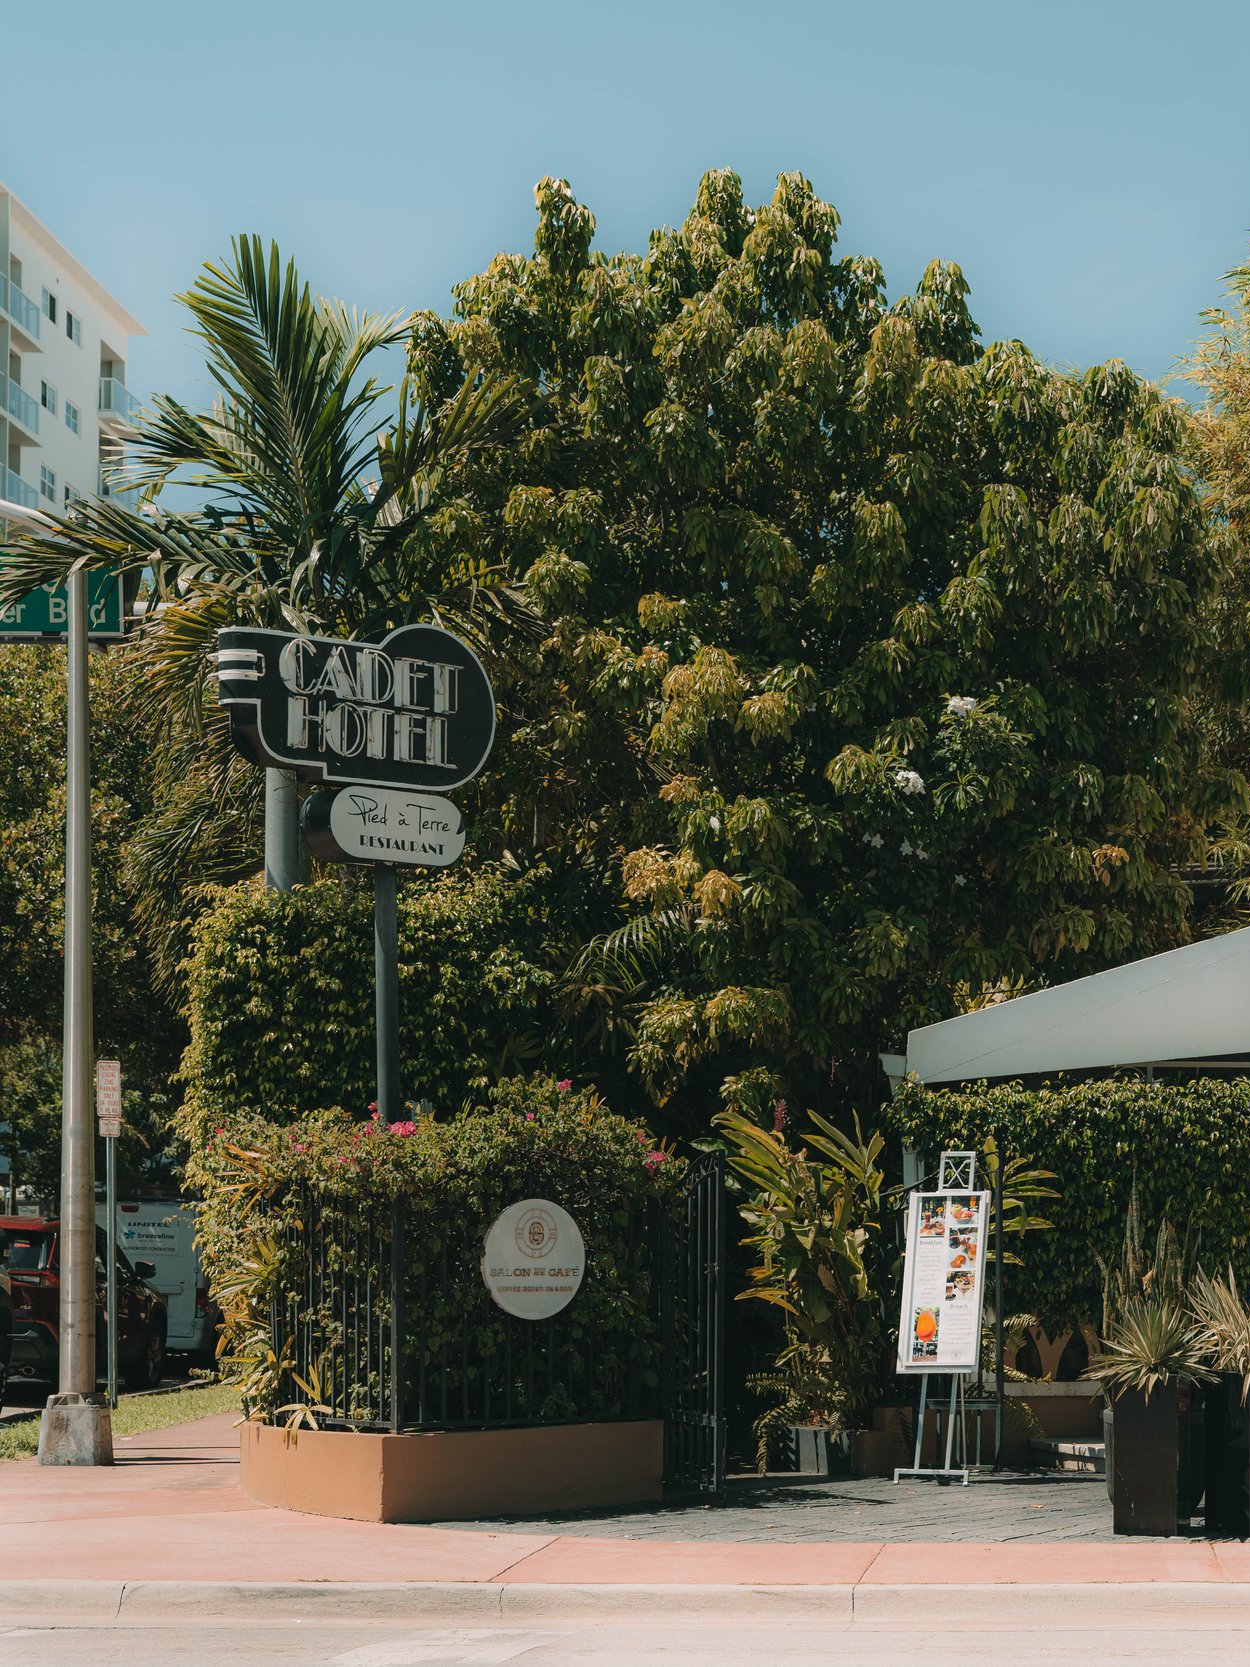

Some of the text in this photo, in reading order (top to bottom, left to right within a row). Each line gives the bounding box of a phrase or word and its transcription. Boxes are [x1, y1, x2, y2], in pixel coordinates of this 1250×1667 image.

[49, 598, 106, 623] Bd
[279, 638, 465, 714] CADET
[287, 696, 458, 769] HOTEL
[348, 794, 451, 835] Pied à Terre
[360, 834, 446, 856] RESTAURANT
[490, 1268, 531, 1277] SALON
